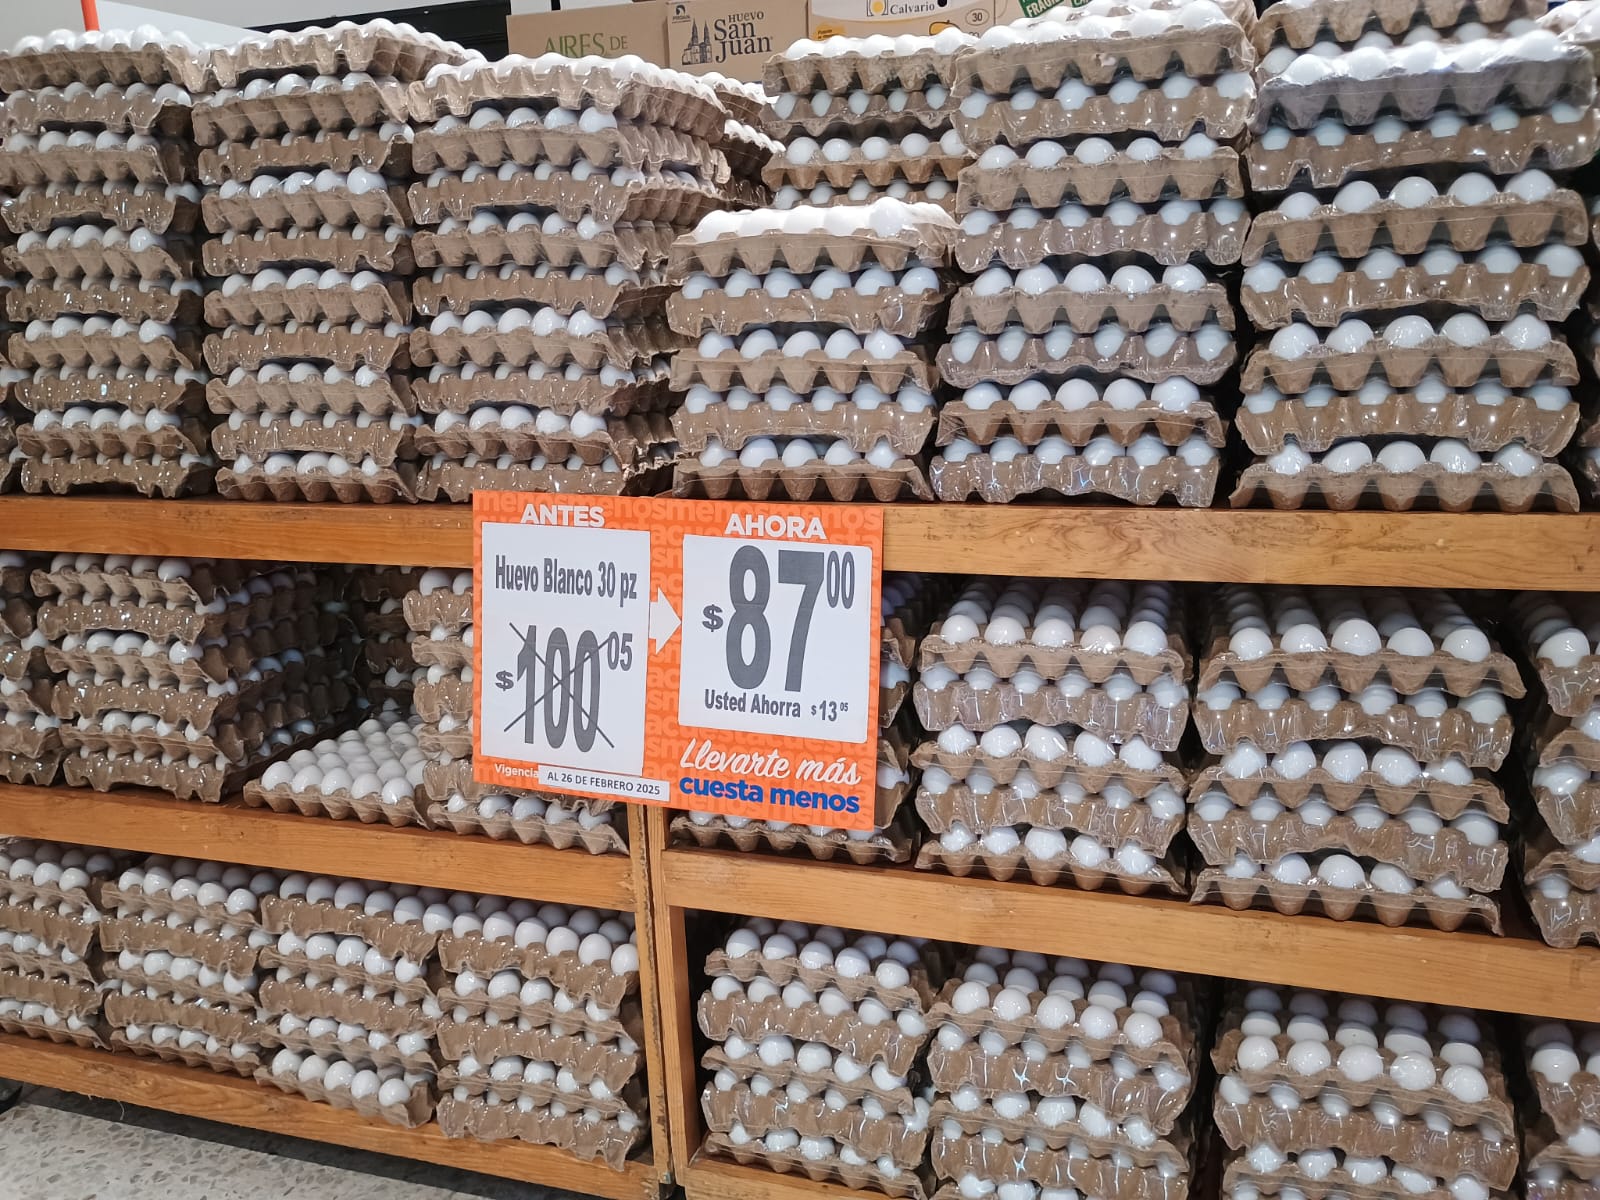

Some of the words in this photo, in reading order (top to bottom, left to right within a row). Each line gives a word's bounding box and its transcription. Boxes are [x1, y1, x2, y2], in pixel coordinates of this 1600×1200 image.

[890, 1, 935, 15] Calvario
[971, 12, 983, 22] 30
[714, 19, 756, 41] San
[609, 35, 629, 51] DE
[715, 36, 772, 63] Juan
[520, 503, 605, 528] ANTES
[724, 513, 828, 540] AHORA
[495, 554, 539, 592] Huevo
[543, 557, 593, 596] Blanco
[597, 560, 616, 599] 30
[620, 571, 638, 608] pz
[704, 688, 747, 713] Usted
[750, 693, 801, 718] Ahorra
[494, 763, 539, 778] Vigencia
[679, 737, 791, 779] Llevarte
[795, 756, 862, 786] más
[547, 771, 560, 782] AL
[561, 772, 573, 784] 26
[575, 774, 588, 786] DE
[590, 776, 633, 792] FEBRERO
[636, 783, 661, 796] 2025
[679, 776, 764, 803] cuesta
[769, 786, 860, 814] menos
